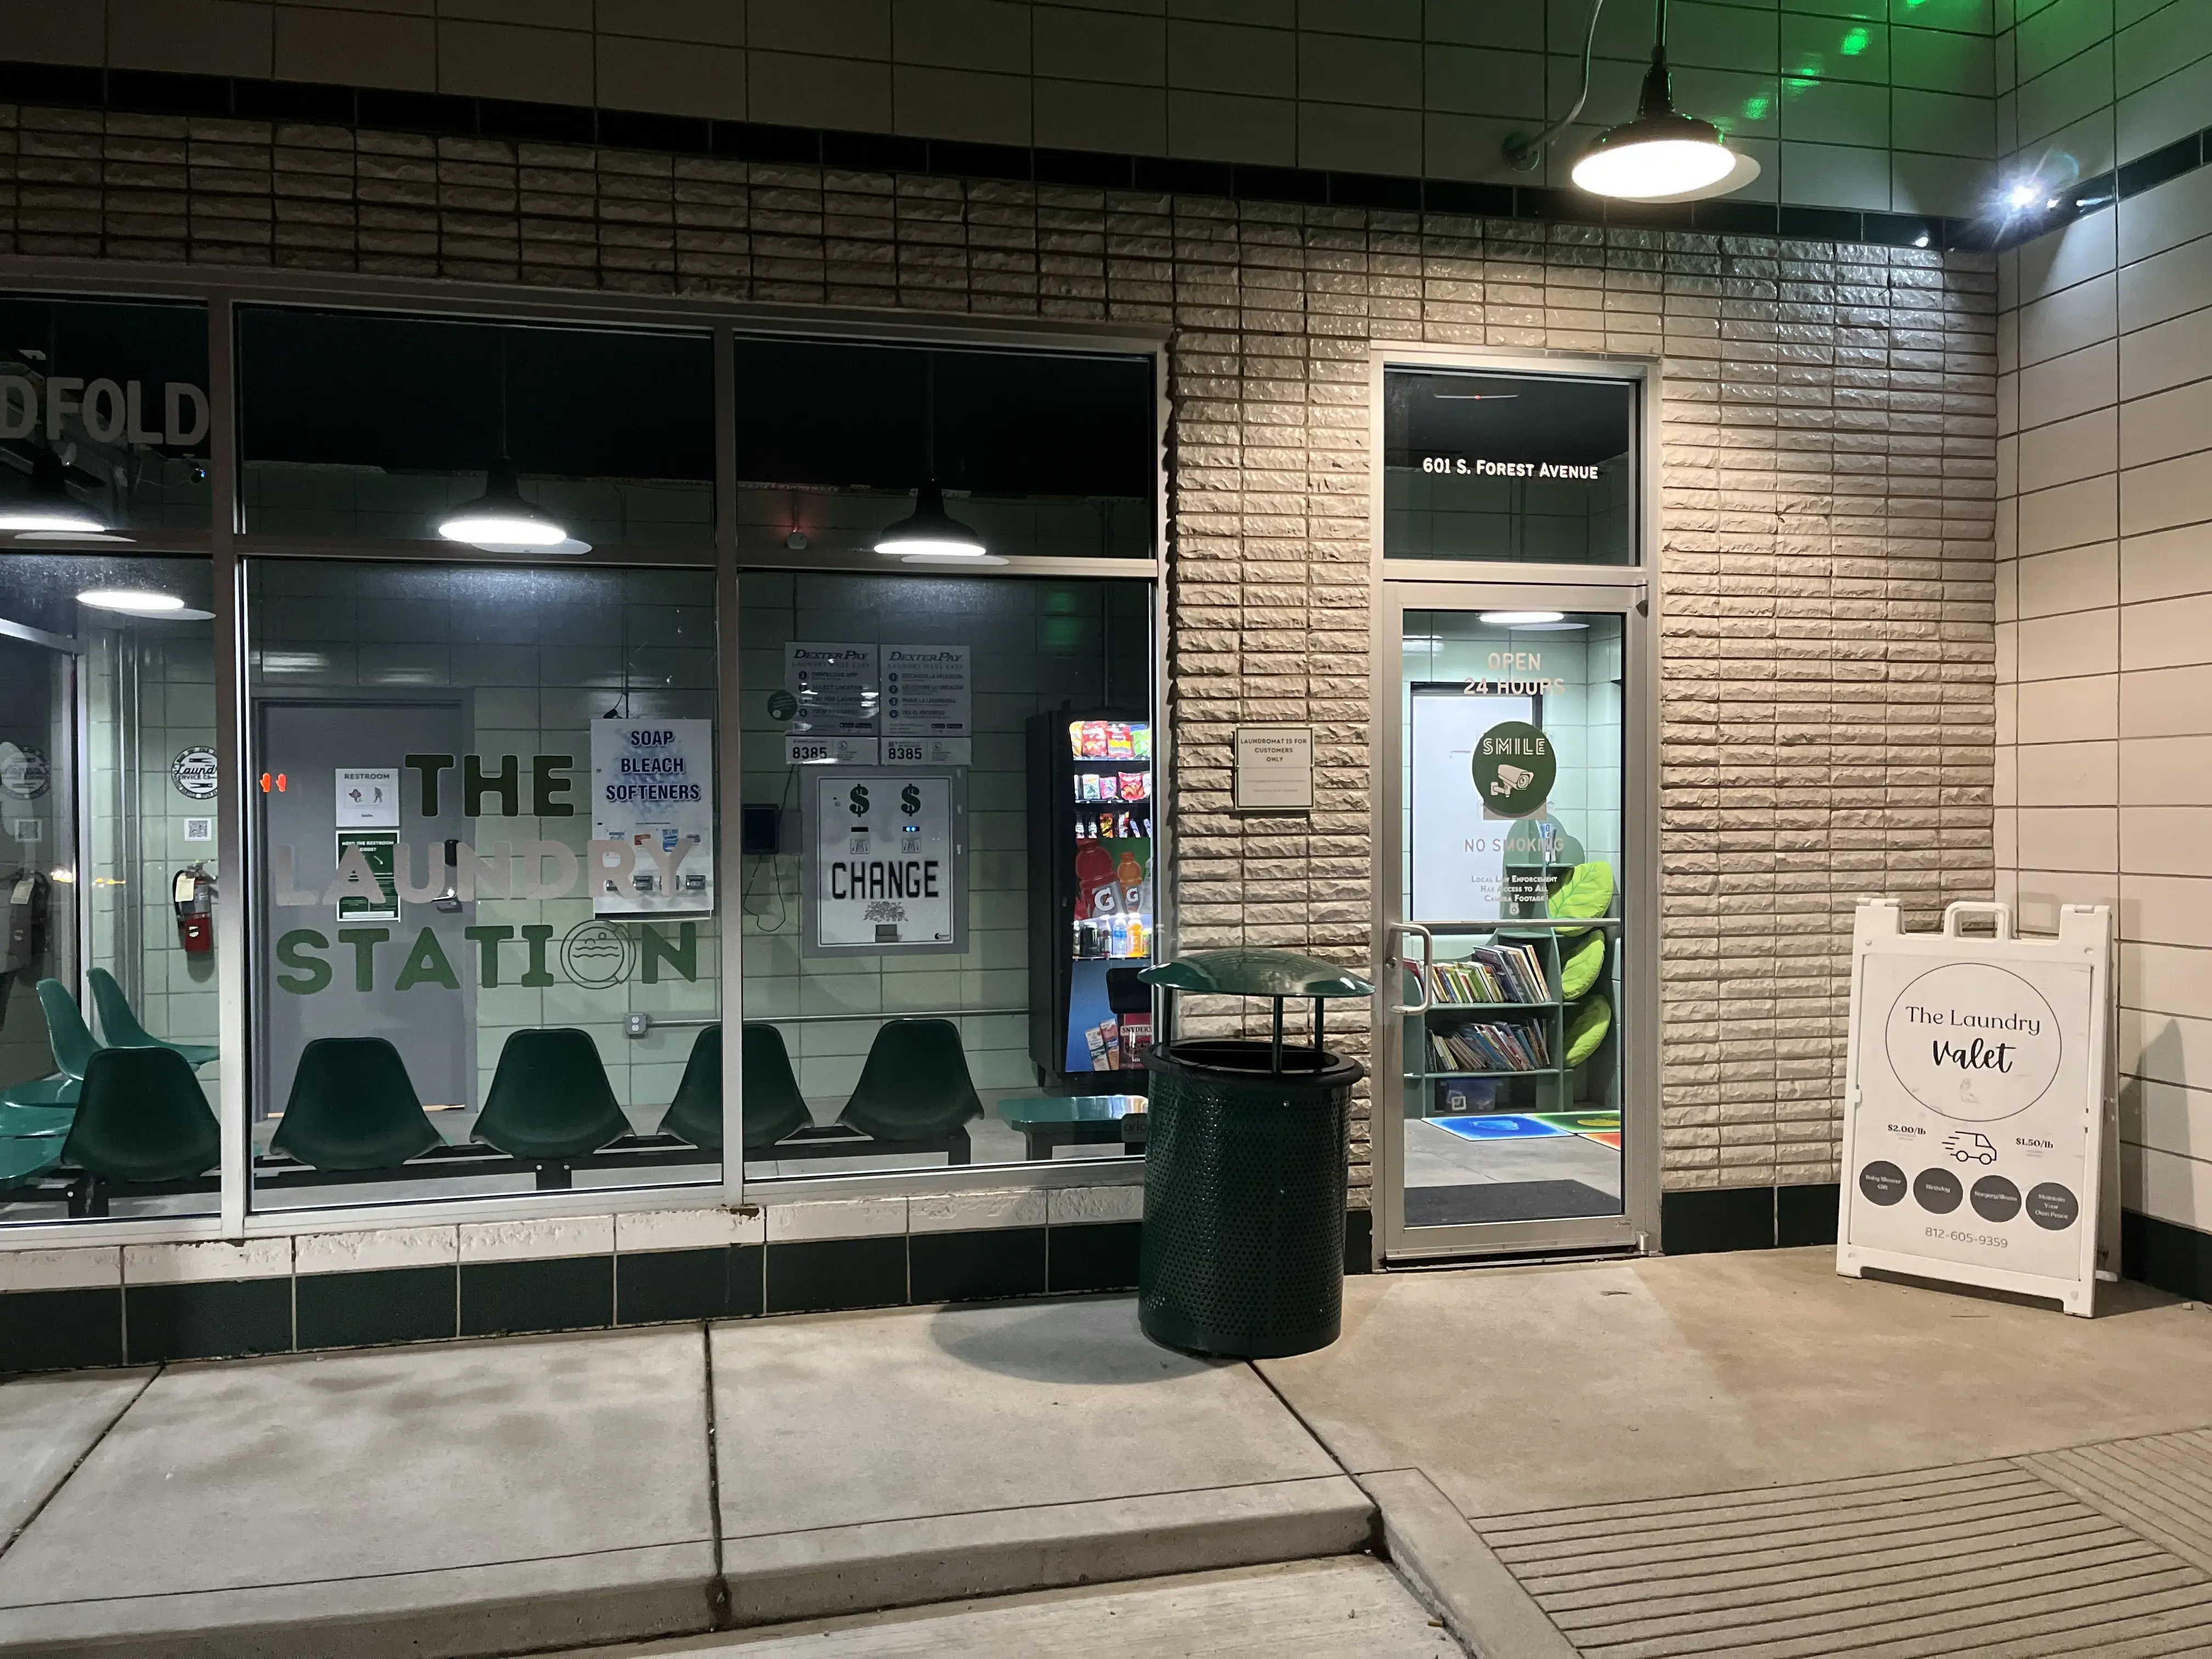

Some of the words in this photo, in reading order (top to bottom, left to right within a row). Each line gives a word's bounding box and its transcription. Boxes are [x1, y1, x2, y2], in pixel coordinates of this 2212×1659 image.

[1423, 457, 1451, 474] 601
[1457, 459, 1471, 475] S.
[1476, 459, 1534, 477] FOREST
[1539, 462, 1598, 479] AVENUE
[1488, 652, 1541, 671] OPEN
[1464, 677, 1488, 695] 24
[1498, 677, 1566, 696] HOURS
[631, 730, 674, 746] SOAP
[792, 747, 827, 759] 8385
[1483, 737, 1545, 755] SMILE
[888, 748, 922, 760] 8385
[173, 763, 217, 775] Laund
[621, 758, 684, 773] BLEACH
[405, 753, 574, 817] THE
[606, 785, 700, 800] SOFTENERS
[1465, 838, 1486, 853] NO
[1492, 838, 1564, 853] SMOKING
[275, 839, 695, 906] LAUNDRY
[832, 861, 939, 900] CHANGE
[1094, 887, 1115, 911] G
[1126, 887, 1138, 902] G
[276, 919, 697, 996] STATION
[1905, 1006, 1944, 1024] The
[1951, 1009, 2040, 1036] Laundry
[1933, 1037, 2016, 1073] Valet
[1124, 1120, 1147, 1132] arlo
[1887, 1124, 1926, 1135] $2.00/lb
[2016, 1137, 2053, 1148] $1.50/lb
[1865, 1174, 1880, 1182] Baby
[1881, 1176, 1901, 1184] Shower
[1926, 1183, 1950, 1193] Birthday
[2038, 1193, 2066, 1203] Maintain
[2050, 1211, 2069, 1220] Peace
[1925, 1227, 2008, 1248] 812-605-9359
